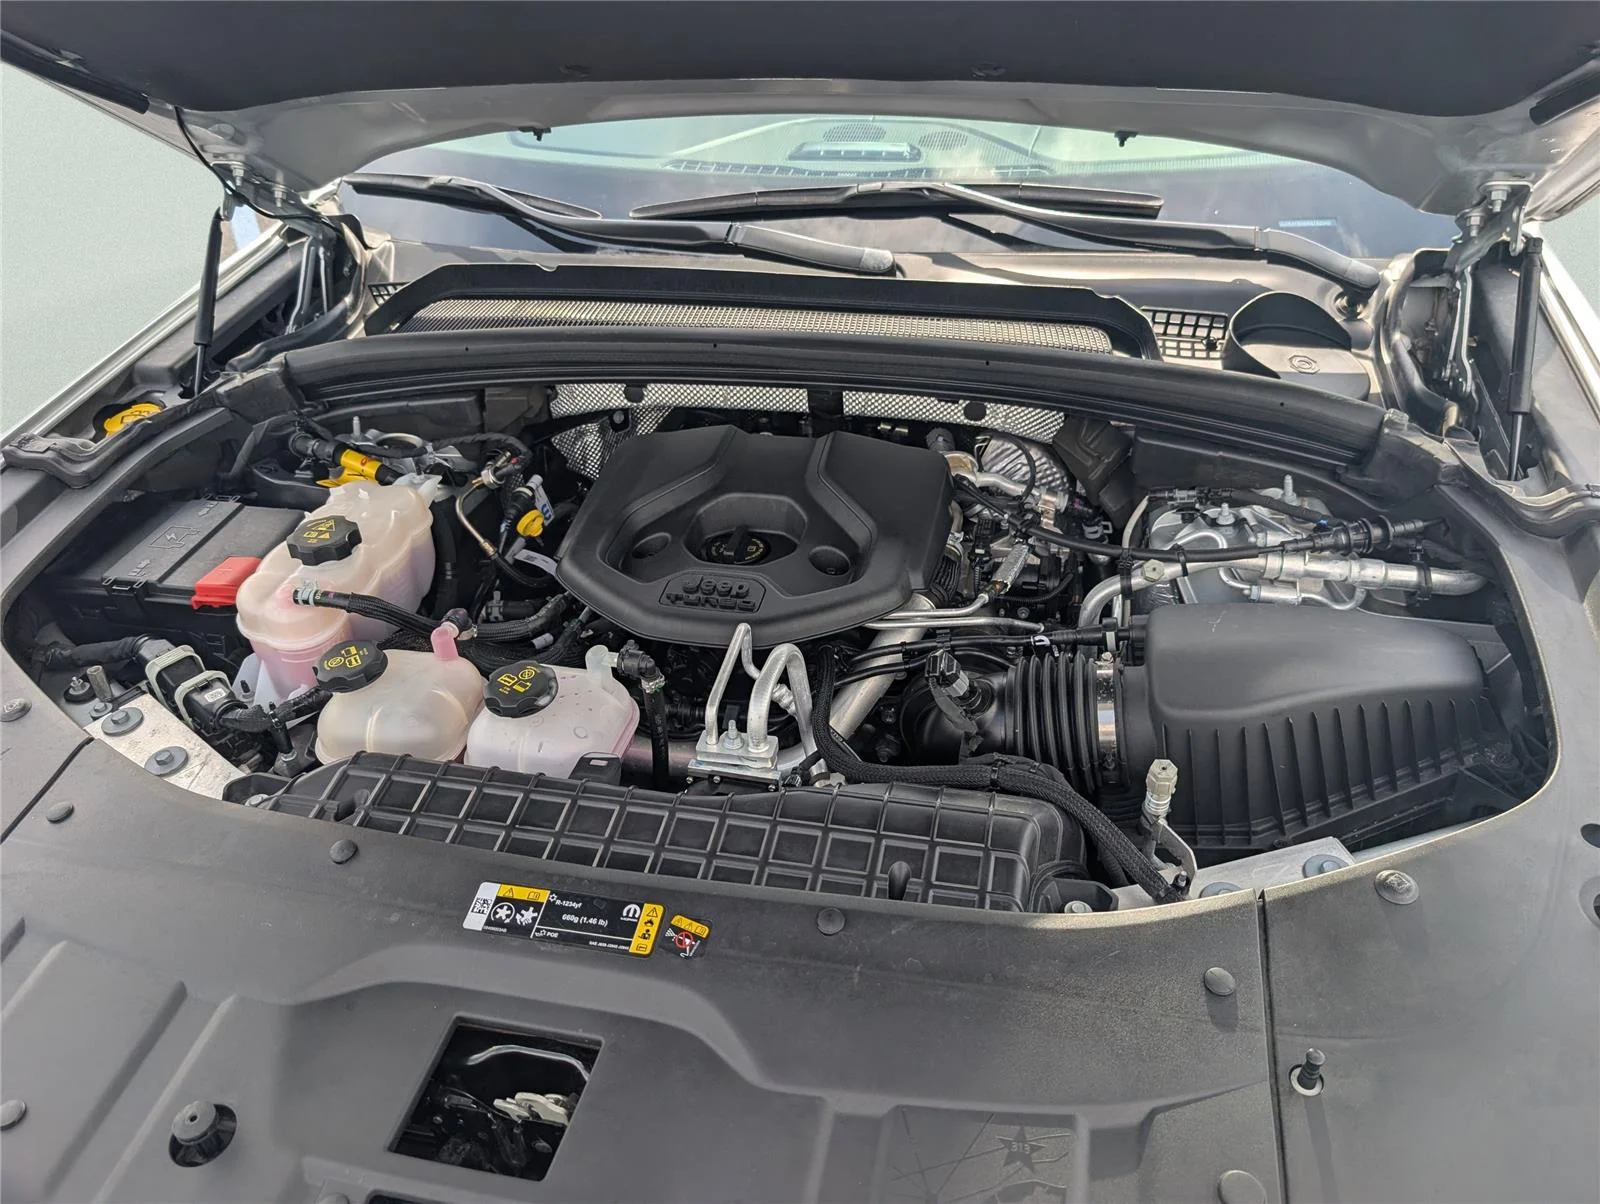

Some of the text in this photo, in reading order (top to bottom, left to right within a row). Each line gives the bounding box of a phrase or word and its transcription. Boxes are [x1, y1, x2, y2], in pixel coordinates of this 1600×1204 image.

[682, 576, 750, 599] Jeep
[666, 593, 756, 612] TURBO
[555, 899, 583, 909] R-1234yf
[598, 918, 608, 928] lb)
[1010, 1141, 1031, 1155] 313
